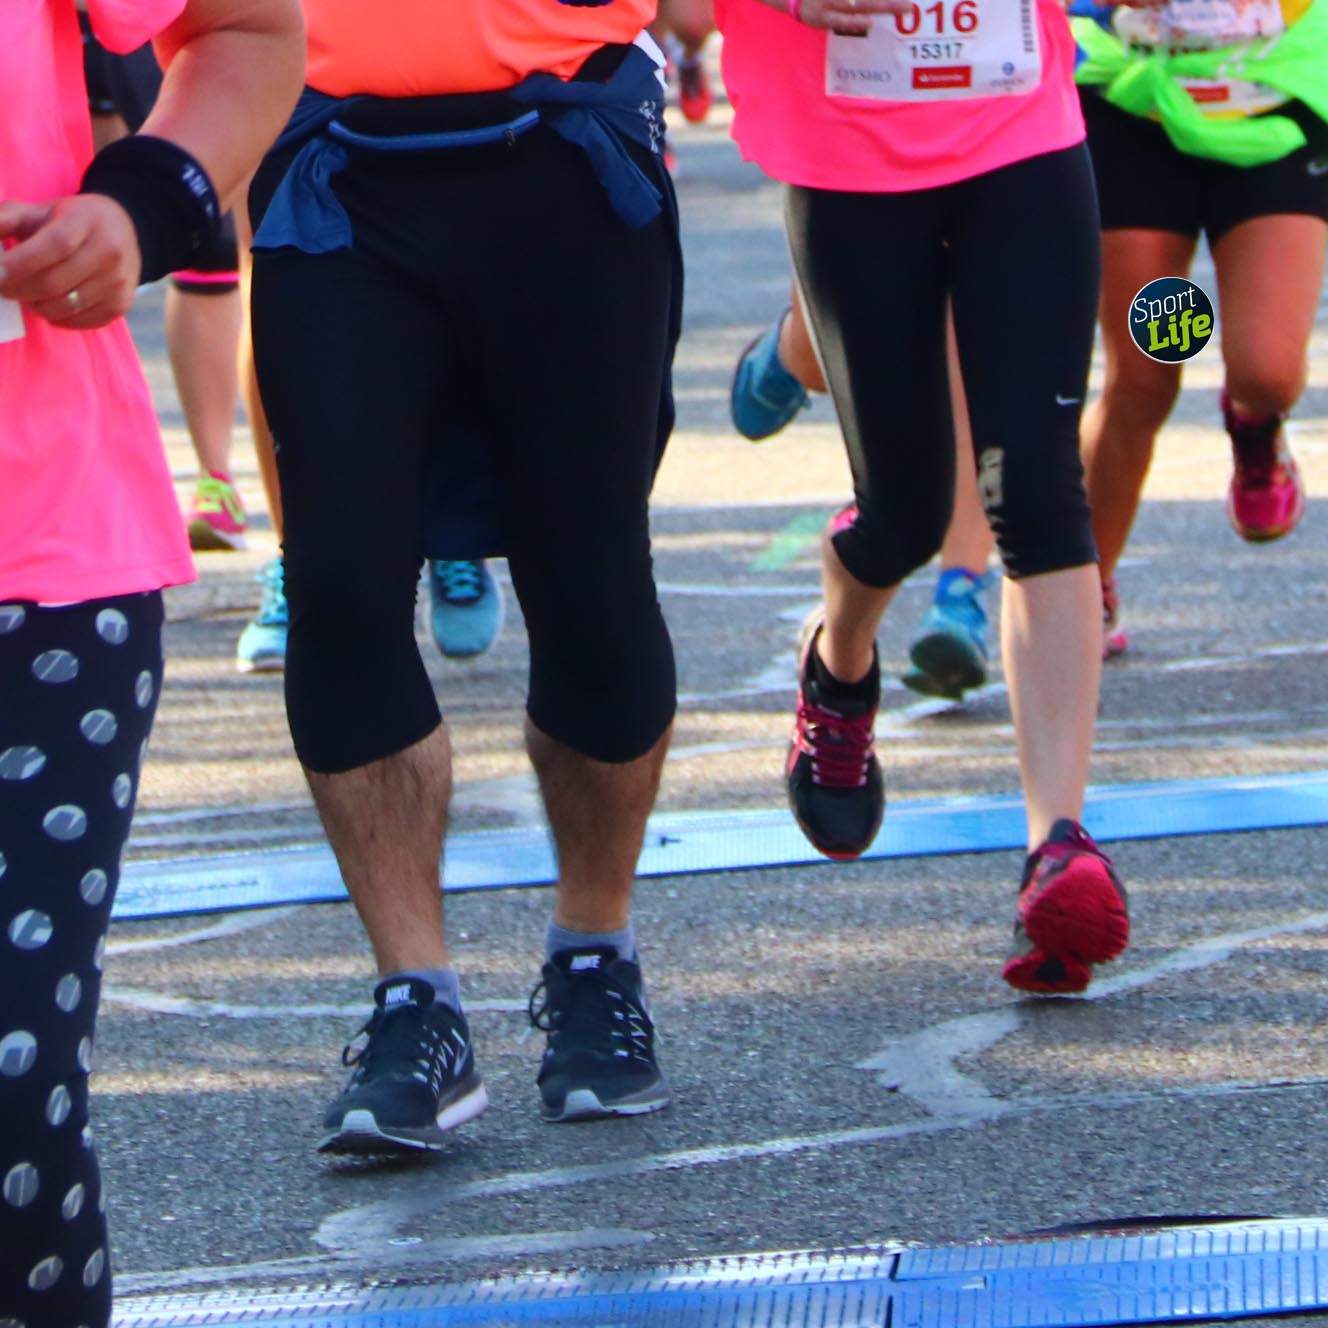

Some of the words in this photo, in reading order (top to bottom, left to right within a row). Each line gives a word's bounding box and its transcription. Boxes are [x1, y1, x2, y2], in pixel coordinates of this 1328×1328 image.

[895, 0, 979, 36] 016
[910, 42, 964, 60] 15317
[385, 983, 413, 1004] NIKE
